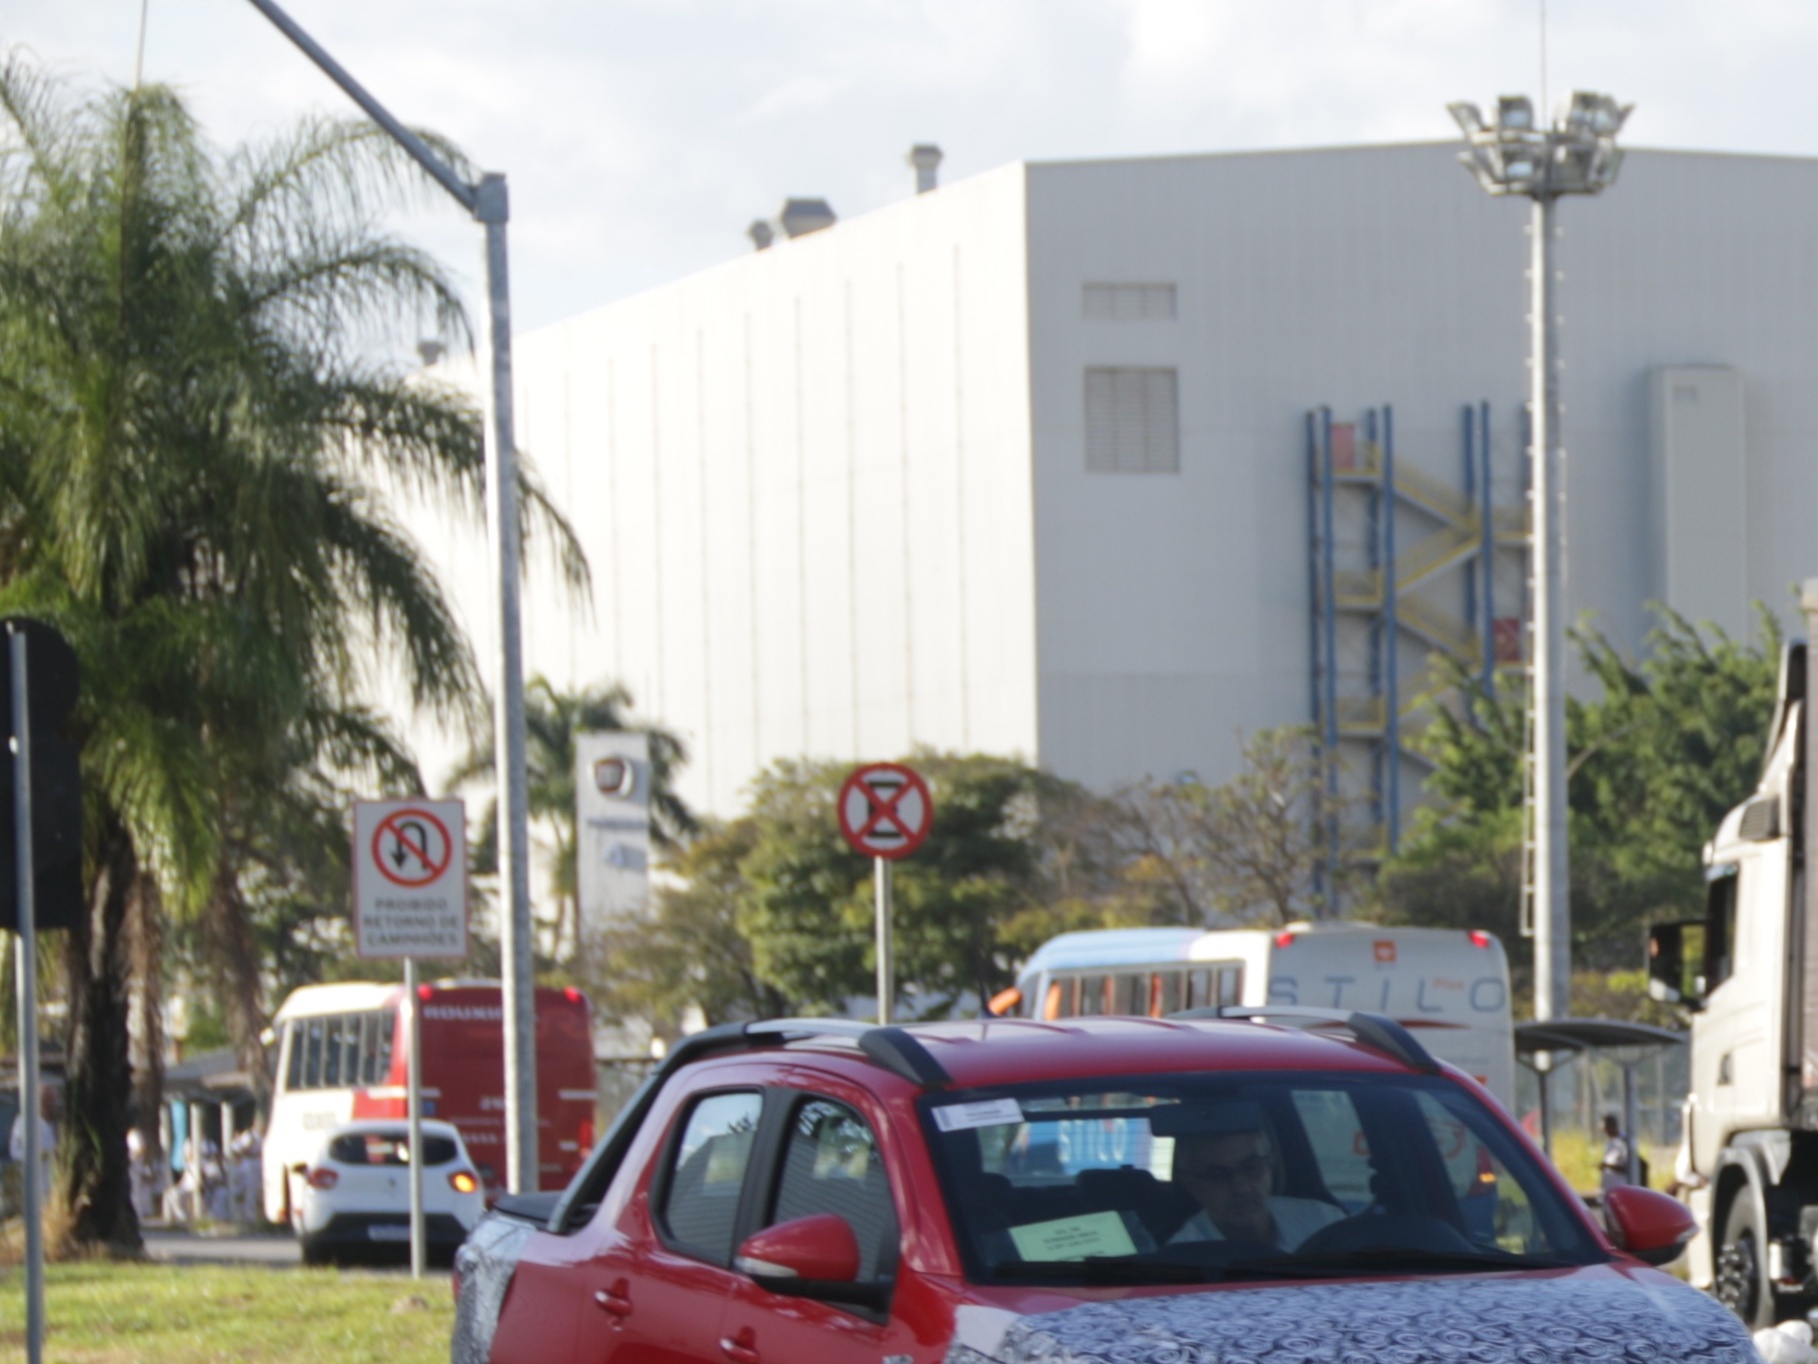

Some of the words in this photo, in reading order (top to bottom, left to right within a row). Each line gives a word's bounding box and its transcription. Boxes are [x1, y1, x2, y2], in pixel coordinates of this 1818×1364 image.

[375, 897, 448, 911] PROIBIDO
[363, 915, 434, 929] RETORNO
[440, 914, 459, 928] DE
[1268, 975, 1507, 1013] STILO
